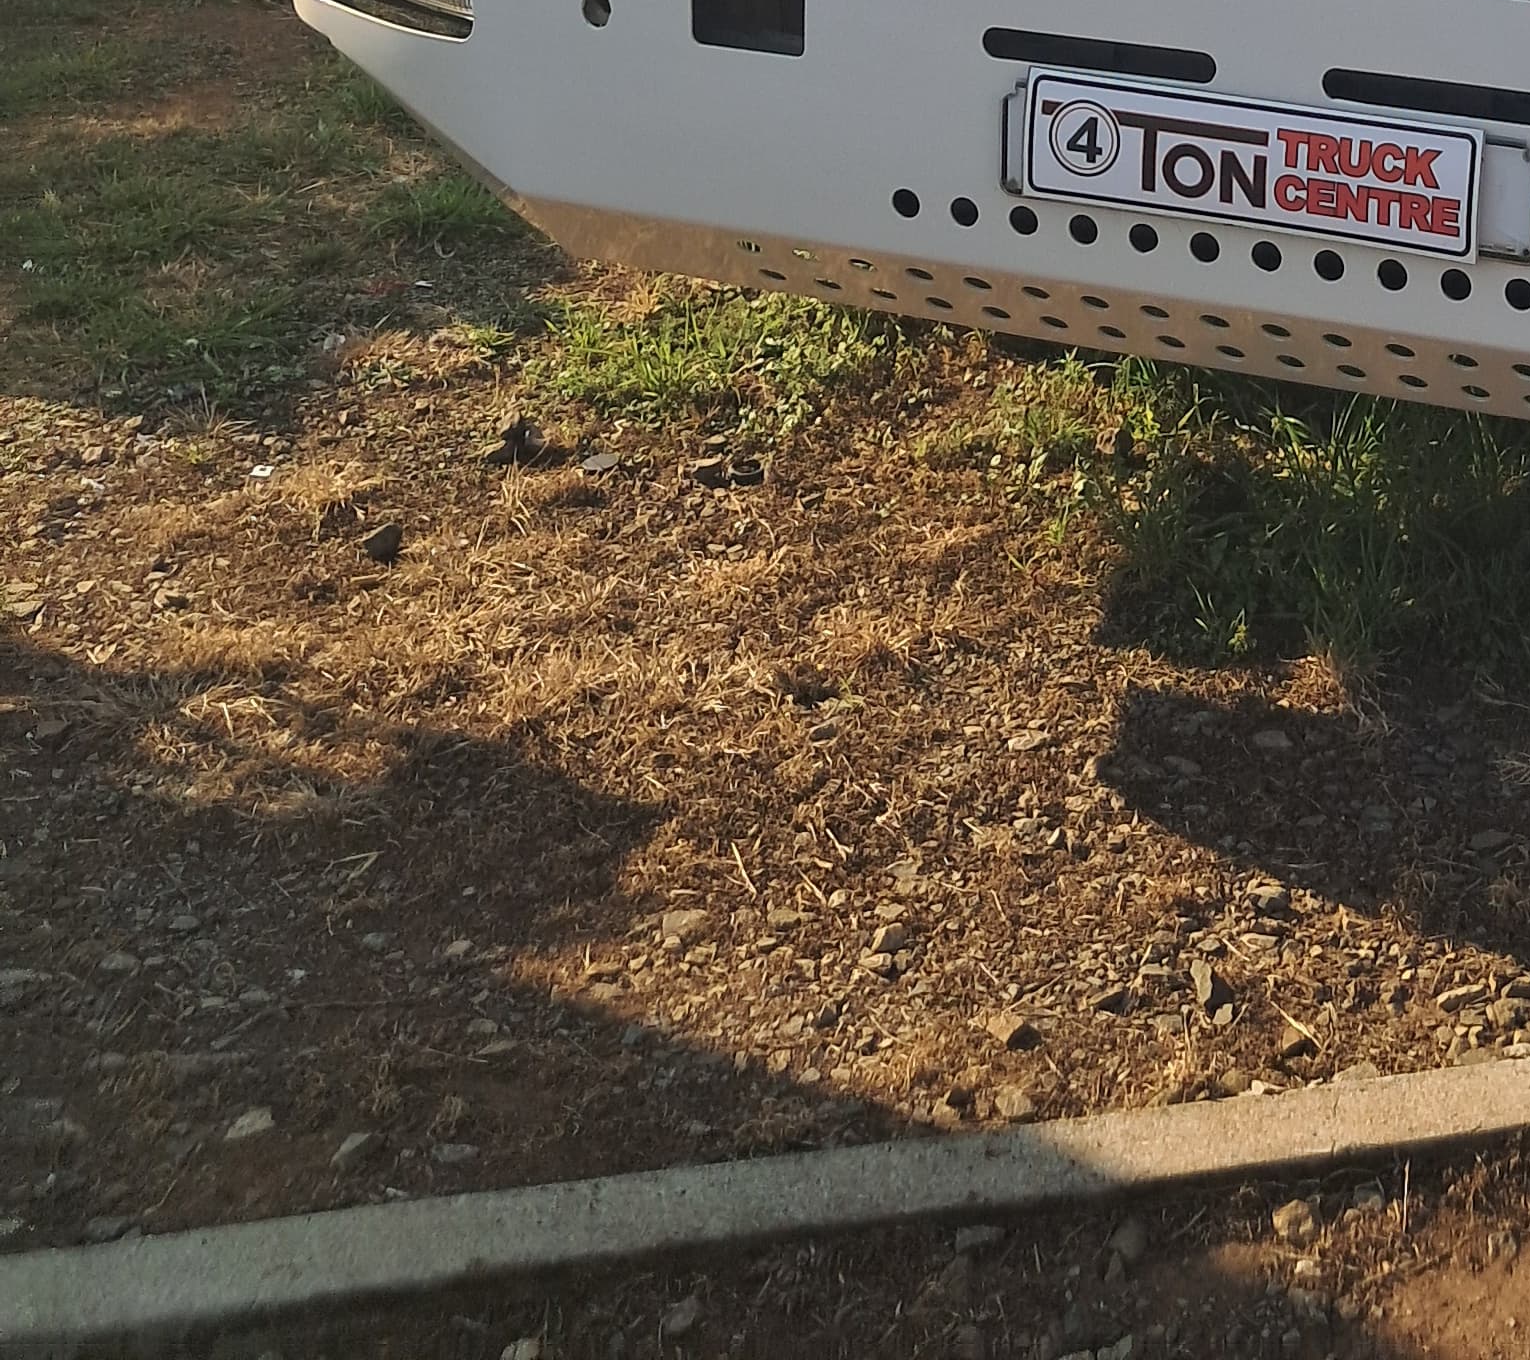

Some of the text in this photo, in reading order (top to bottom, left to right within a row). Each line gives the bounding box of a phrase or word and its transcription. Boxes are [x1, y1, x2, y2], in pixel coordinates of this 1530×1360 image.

[1065, 116, 1103, 164] 4
[1276, 127, 1444, 190] TRUCK
[1273, 173, 1462, 238] CENTRE
